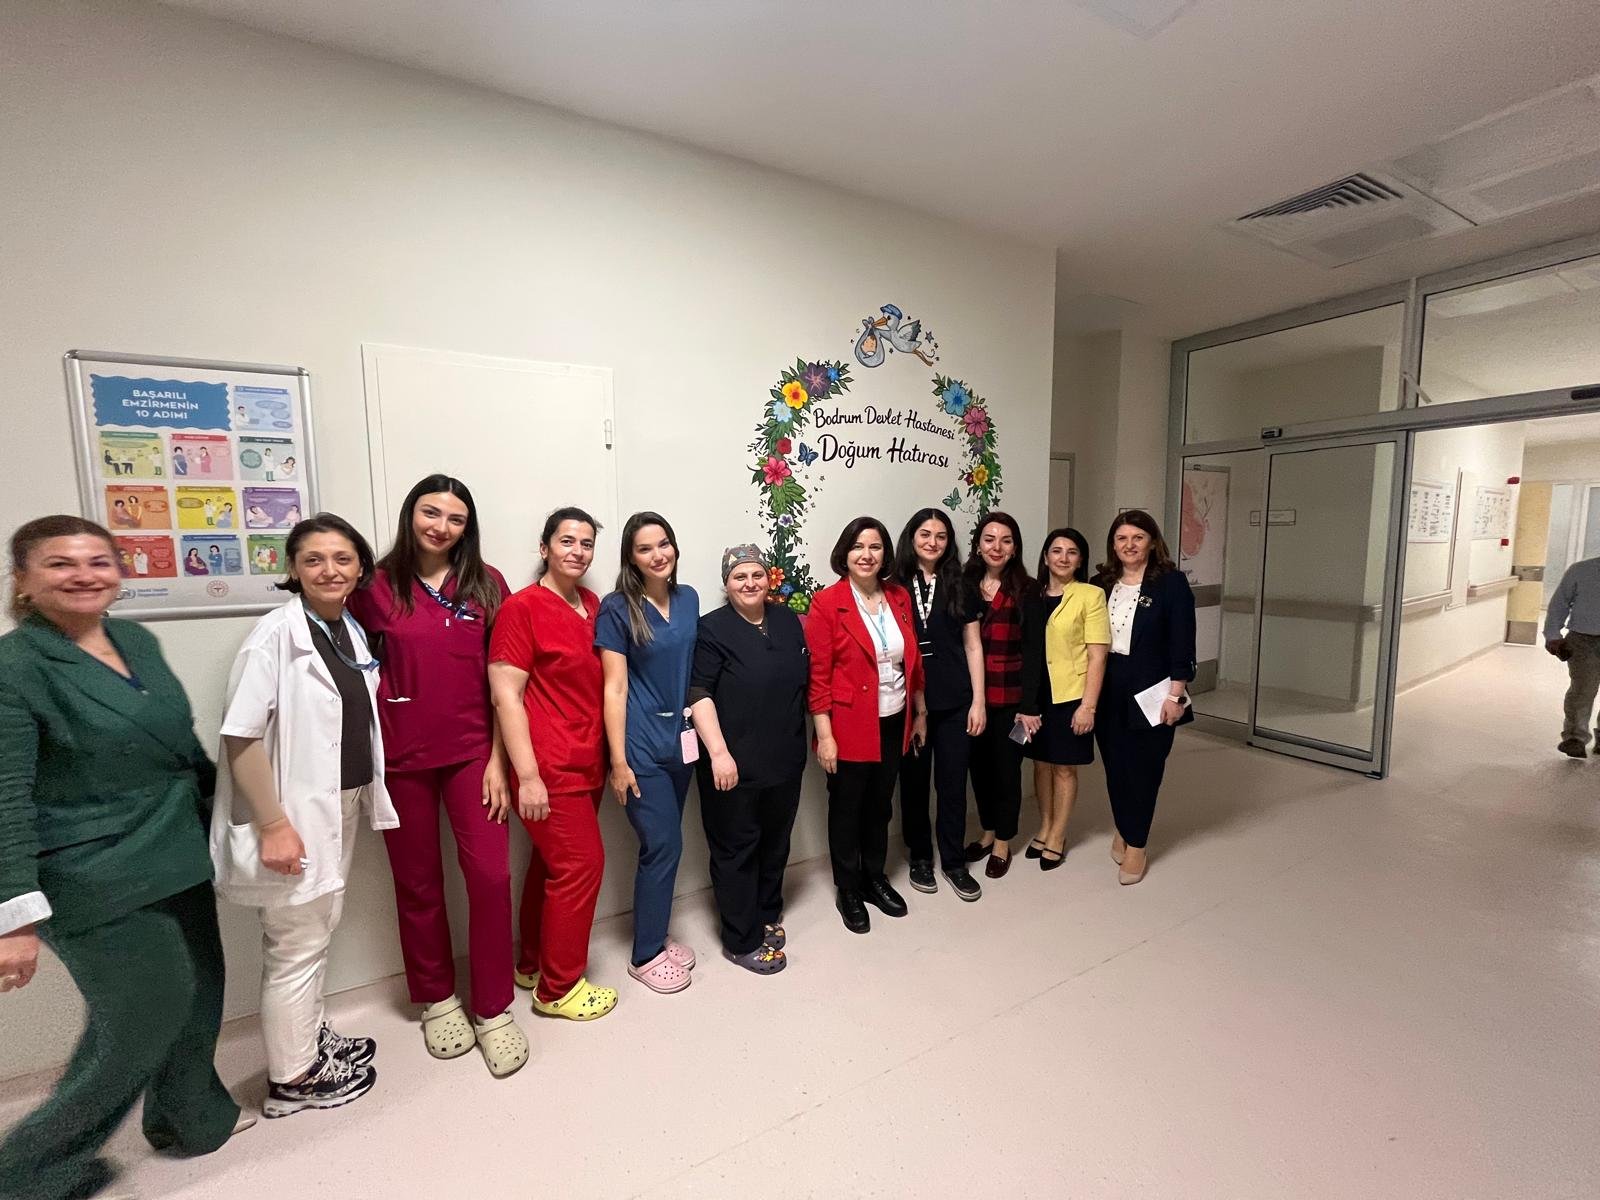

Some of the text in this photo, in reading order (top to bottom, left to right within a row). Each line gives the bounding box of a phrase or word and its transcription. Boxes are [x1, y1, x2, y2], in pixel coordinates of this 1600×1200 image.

[133, 389, 187, 400] BAŞARILI
[122, 399, 199, 410] EMZİRMENİN
[136, 410, 188, 420] 10 ADIMI
[813, 405, 956, 440] Bodrum Devlet Hastanesi
[817, 433, 950, 469] Doğum Hatırası
